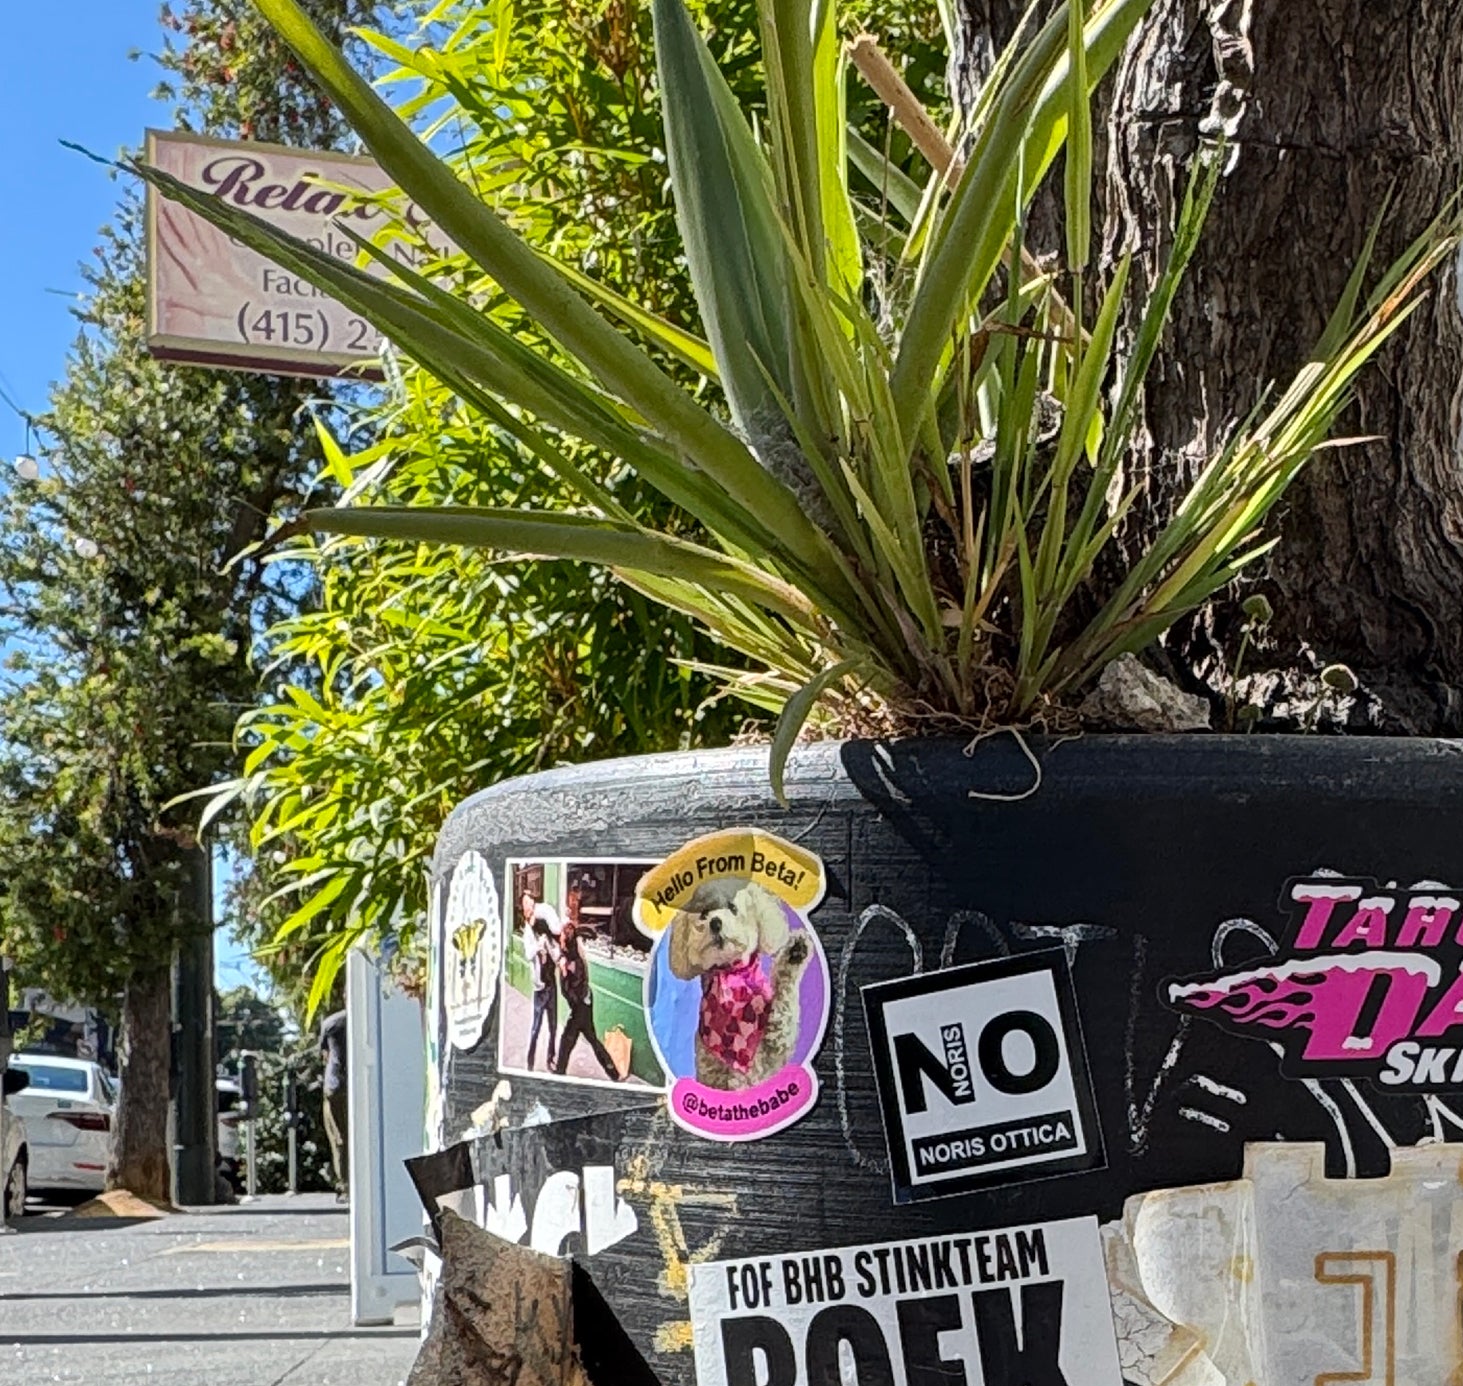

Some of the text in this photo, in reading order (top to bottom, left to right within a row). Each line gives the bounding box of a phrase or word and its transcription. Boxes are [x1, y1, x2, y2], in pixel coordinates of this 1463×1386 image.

[237, 300, 329, 351] (415)
[651, 852, 806, 914] Hello From Beta!
[943, 1025, 972, 1098] NORIS
[682, 1082, 800, 1122] @betathebabe
[919, 1122, 1072, 1166] NORIS OTTICA
[726, 1228, 1050, 1310] FOF BHB STINKTEAM
